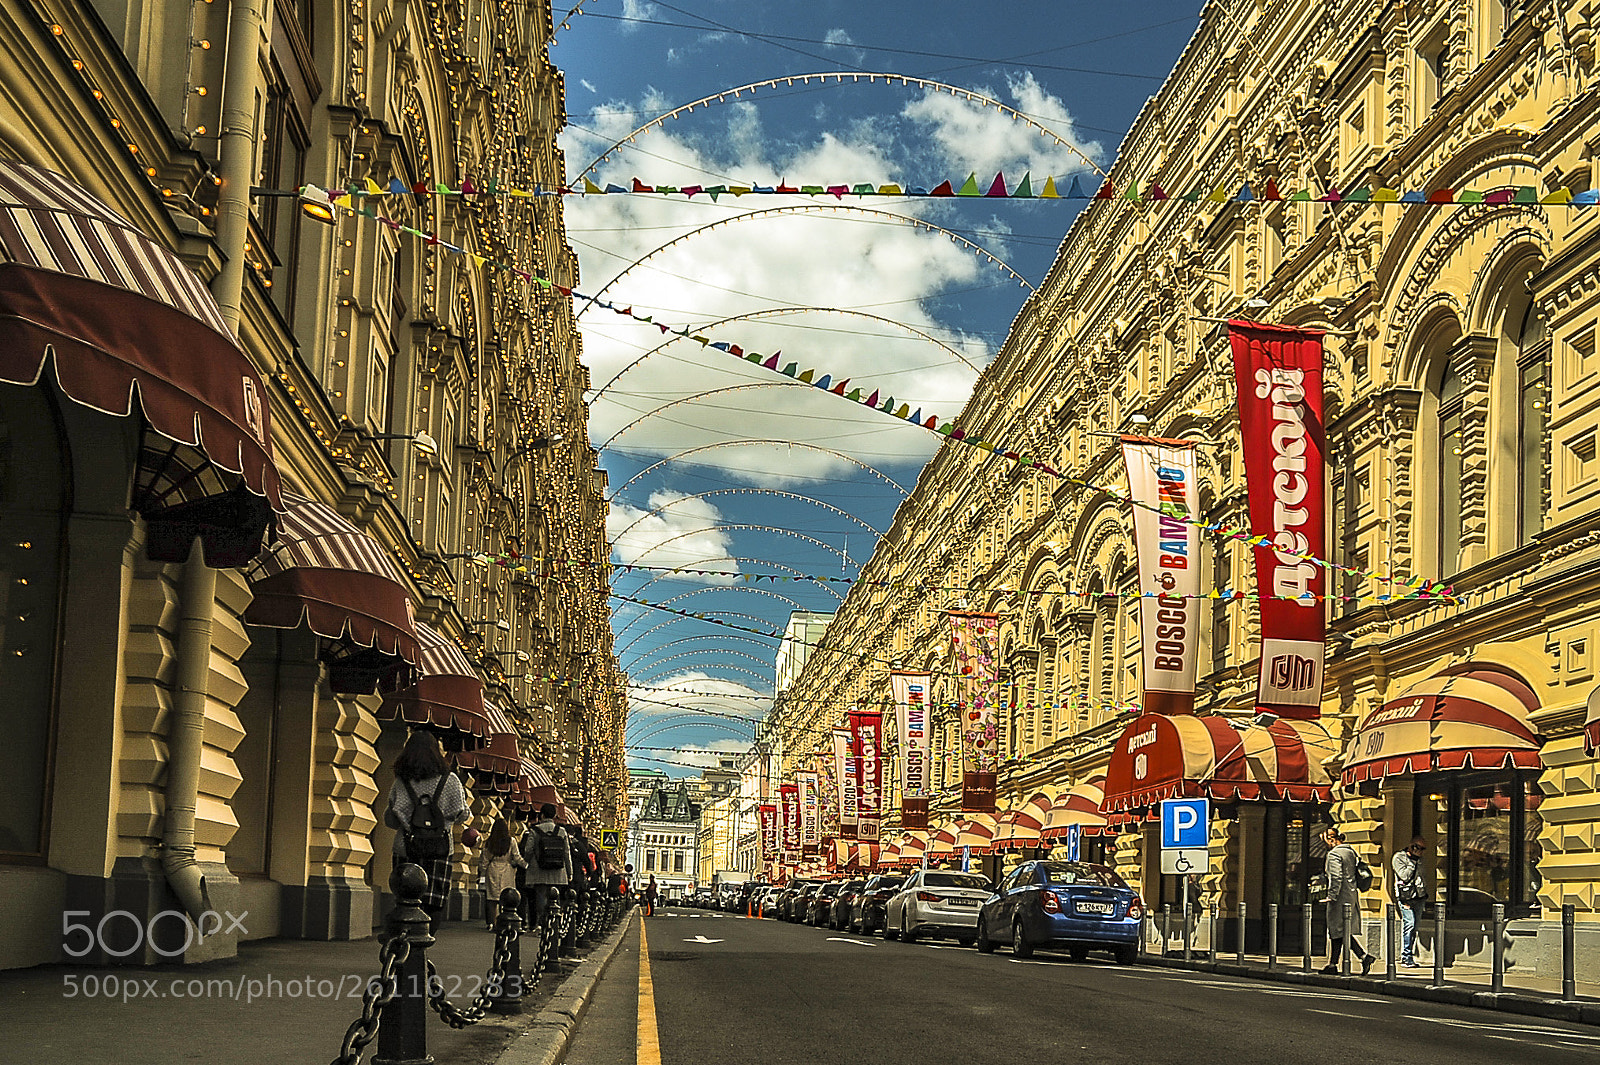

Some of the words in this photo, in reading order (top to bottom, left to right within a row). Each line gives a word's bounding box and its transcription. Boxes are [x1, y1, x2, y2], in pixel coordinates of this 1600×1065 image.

[1157, 467, 1188, 570] BAMBINO
[1255, 368, 1316, 607] Детский
[1154, 597, 1187, 672] BOSCO
[907, 751, 923, 789] BOSCO
[1173, 805, 1199, 843] P
